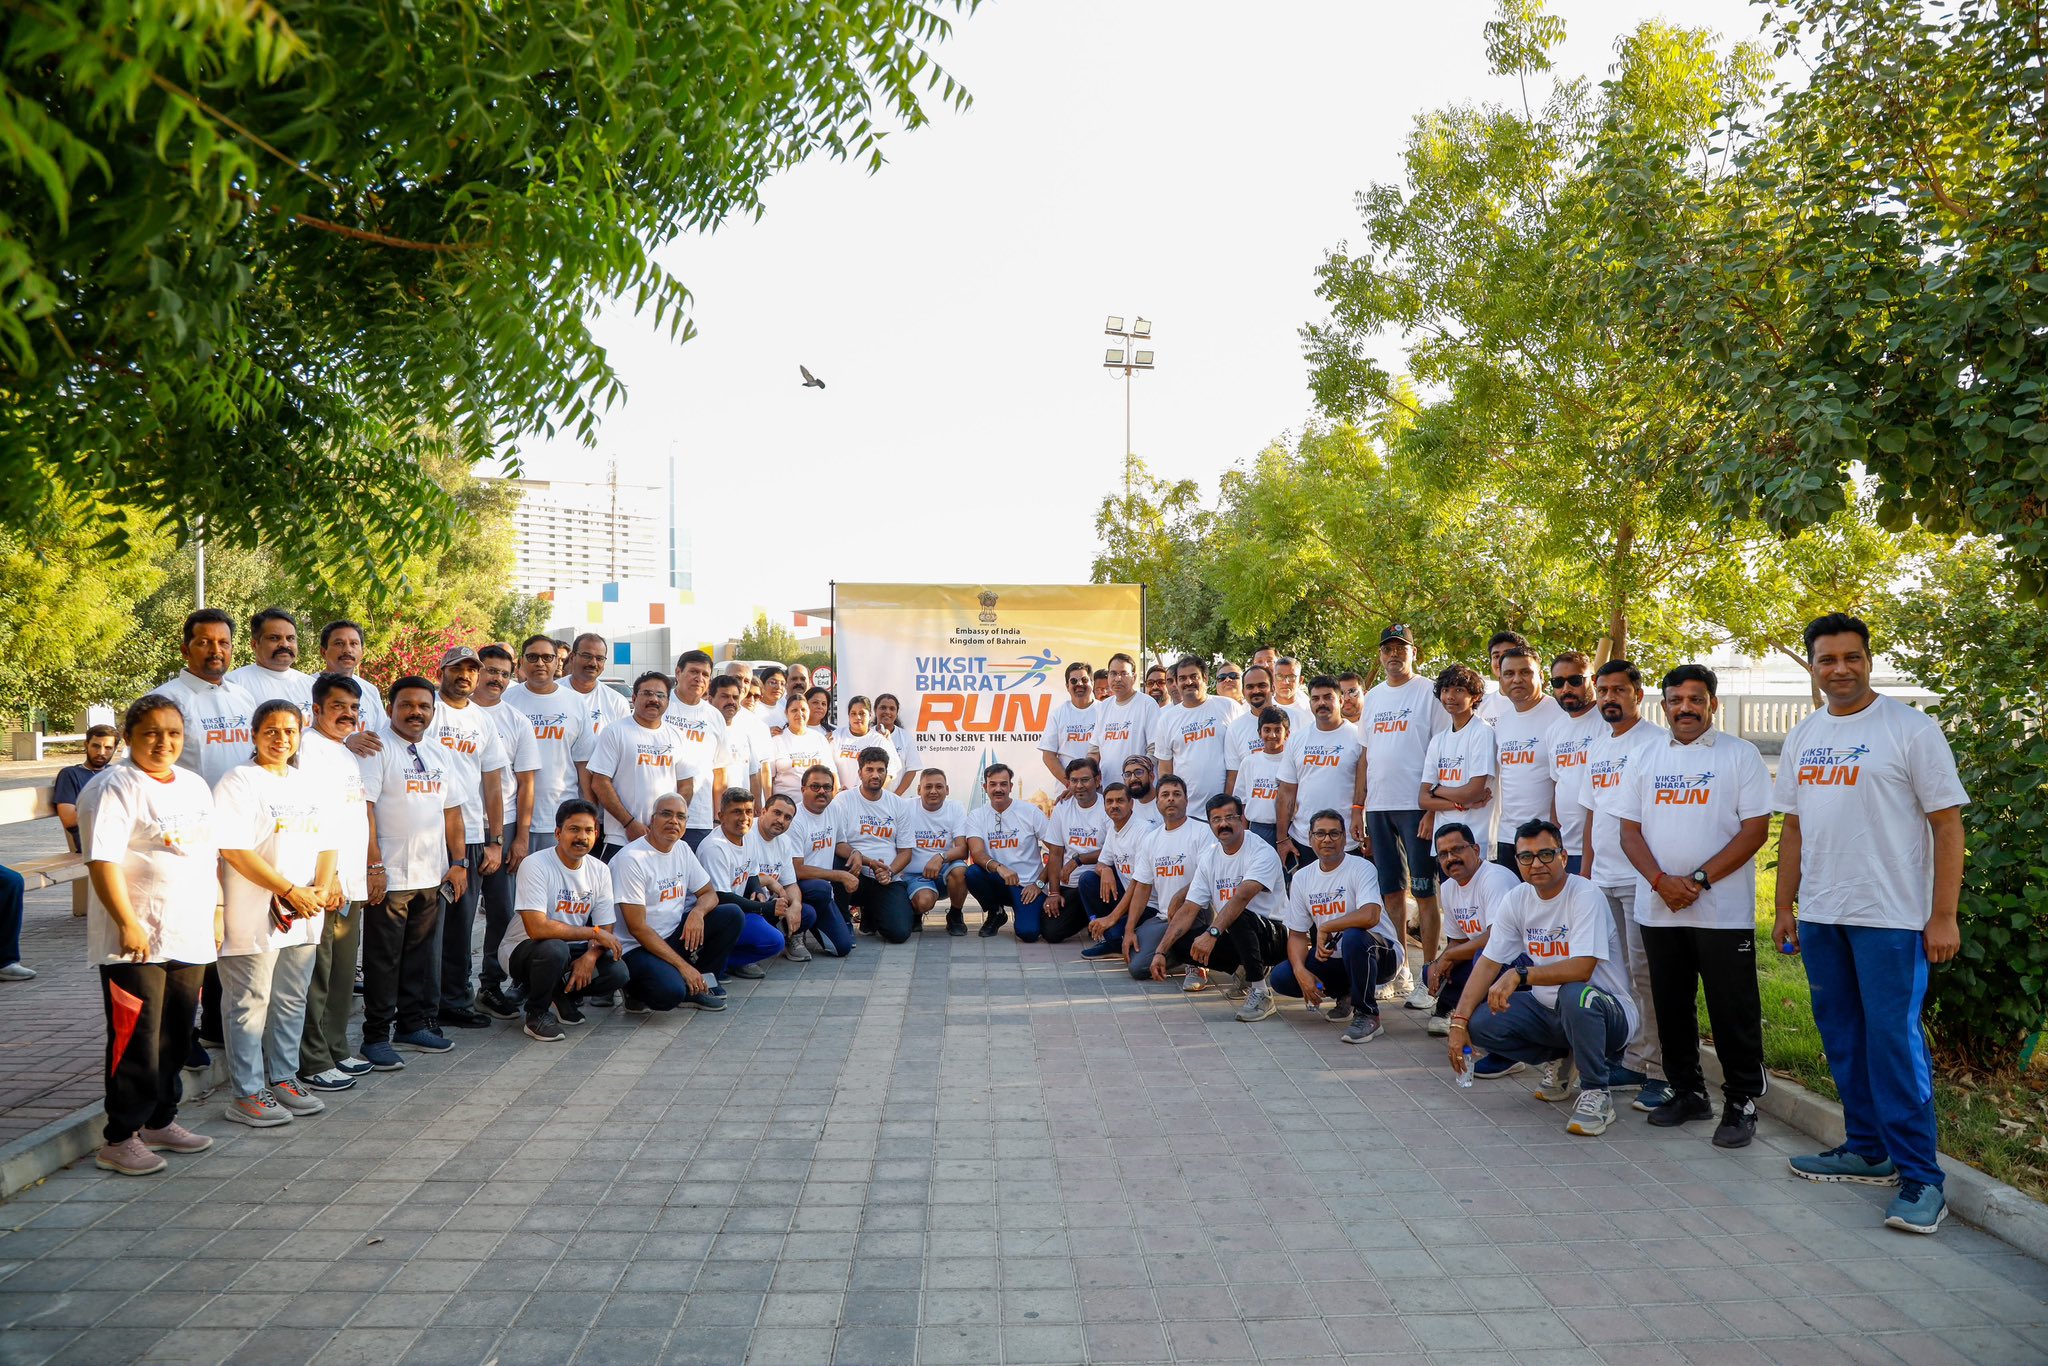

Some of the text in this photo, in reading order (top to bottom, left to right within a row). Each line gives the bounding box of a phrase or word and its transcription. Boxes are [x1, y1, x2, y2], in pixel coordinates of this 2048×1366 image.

[955, 628, 989, 636] Embassy
[915, 656, 987, 674] VIKSIT
[915, 674, 1006, 691] BHARAT
[916, 693, 1052, 732] RUN
[201, 716, 226, 725] VIKSIT
[666, 715, 687, 723] VIKSIT
[203, 722, 234, 730] BHARAT
[1374, 720, 1408, 734] RUN
[207, 728, 249, 745] RUN
[534, 726, 565, 740] UN
[916, 733, 936, 742] RUN
[939, 733, 952, 742] TO
[955, 733, 985, 742] SERVE
[989, 733, 1007, 742] THE
[1104, 730, 1129, 741] RUN
[1184, 727, 1215, 744] RUN
[929, 745, 959, 753] September
[1556, 741, 1575, 749] VIKSIT
[840, 750, 860, 760] RU
[1501, 750, 1535, 765] RUN
[1802, 747, 1833, 757] VIKSIT
[638, 754, 673, 767] RUN
[1303, 755, 1340, 767] RUN
[1556, 750, 1587, 768] RUN
[1591, 760, 1610, 769] VIKSIT
[1799, 756, 1841, 765] BHARAT
[1591, 766, 1615, 775] BHARAT
[1797, 765, 1860, 786] RUN
[1655, 774, 1684, 782] VIKSIT
[407, 780, 442, 794] RUN
[1655, 781, 1691, 789] BHARAT
[1655, 788, 1710, 805] RUN
[860, 824, 893, 839] RUN
[916, 838, 946, 849] RUN
[989, 838, 1018, 849] RUN
[1069, 836, 1098, 847] RUN
[1156, 865, 1184, 877] RUN
[555, 900, 591, 914] RUN
[1311, 901, 1345, 916] RUN
[1457, 919, 1482, 934] RUN
[1527, 934, 1554, 942] BHARAT
[1528, 941, 1569, 957] RUN
